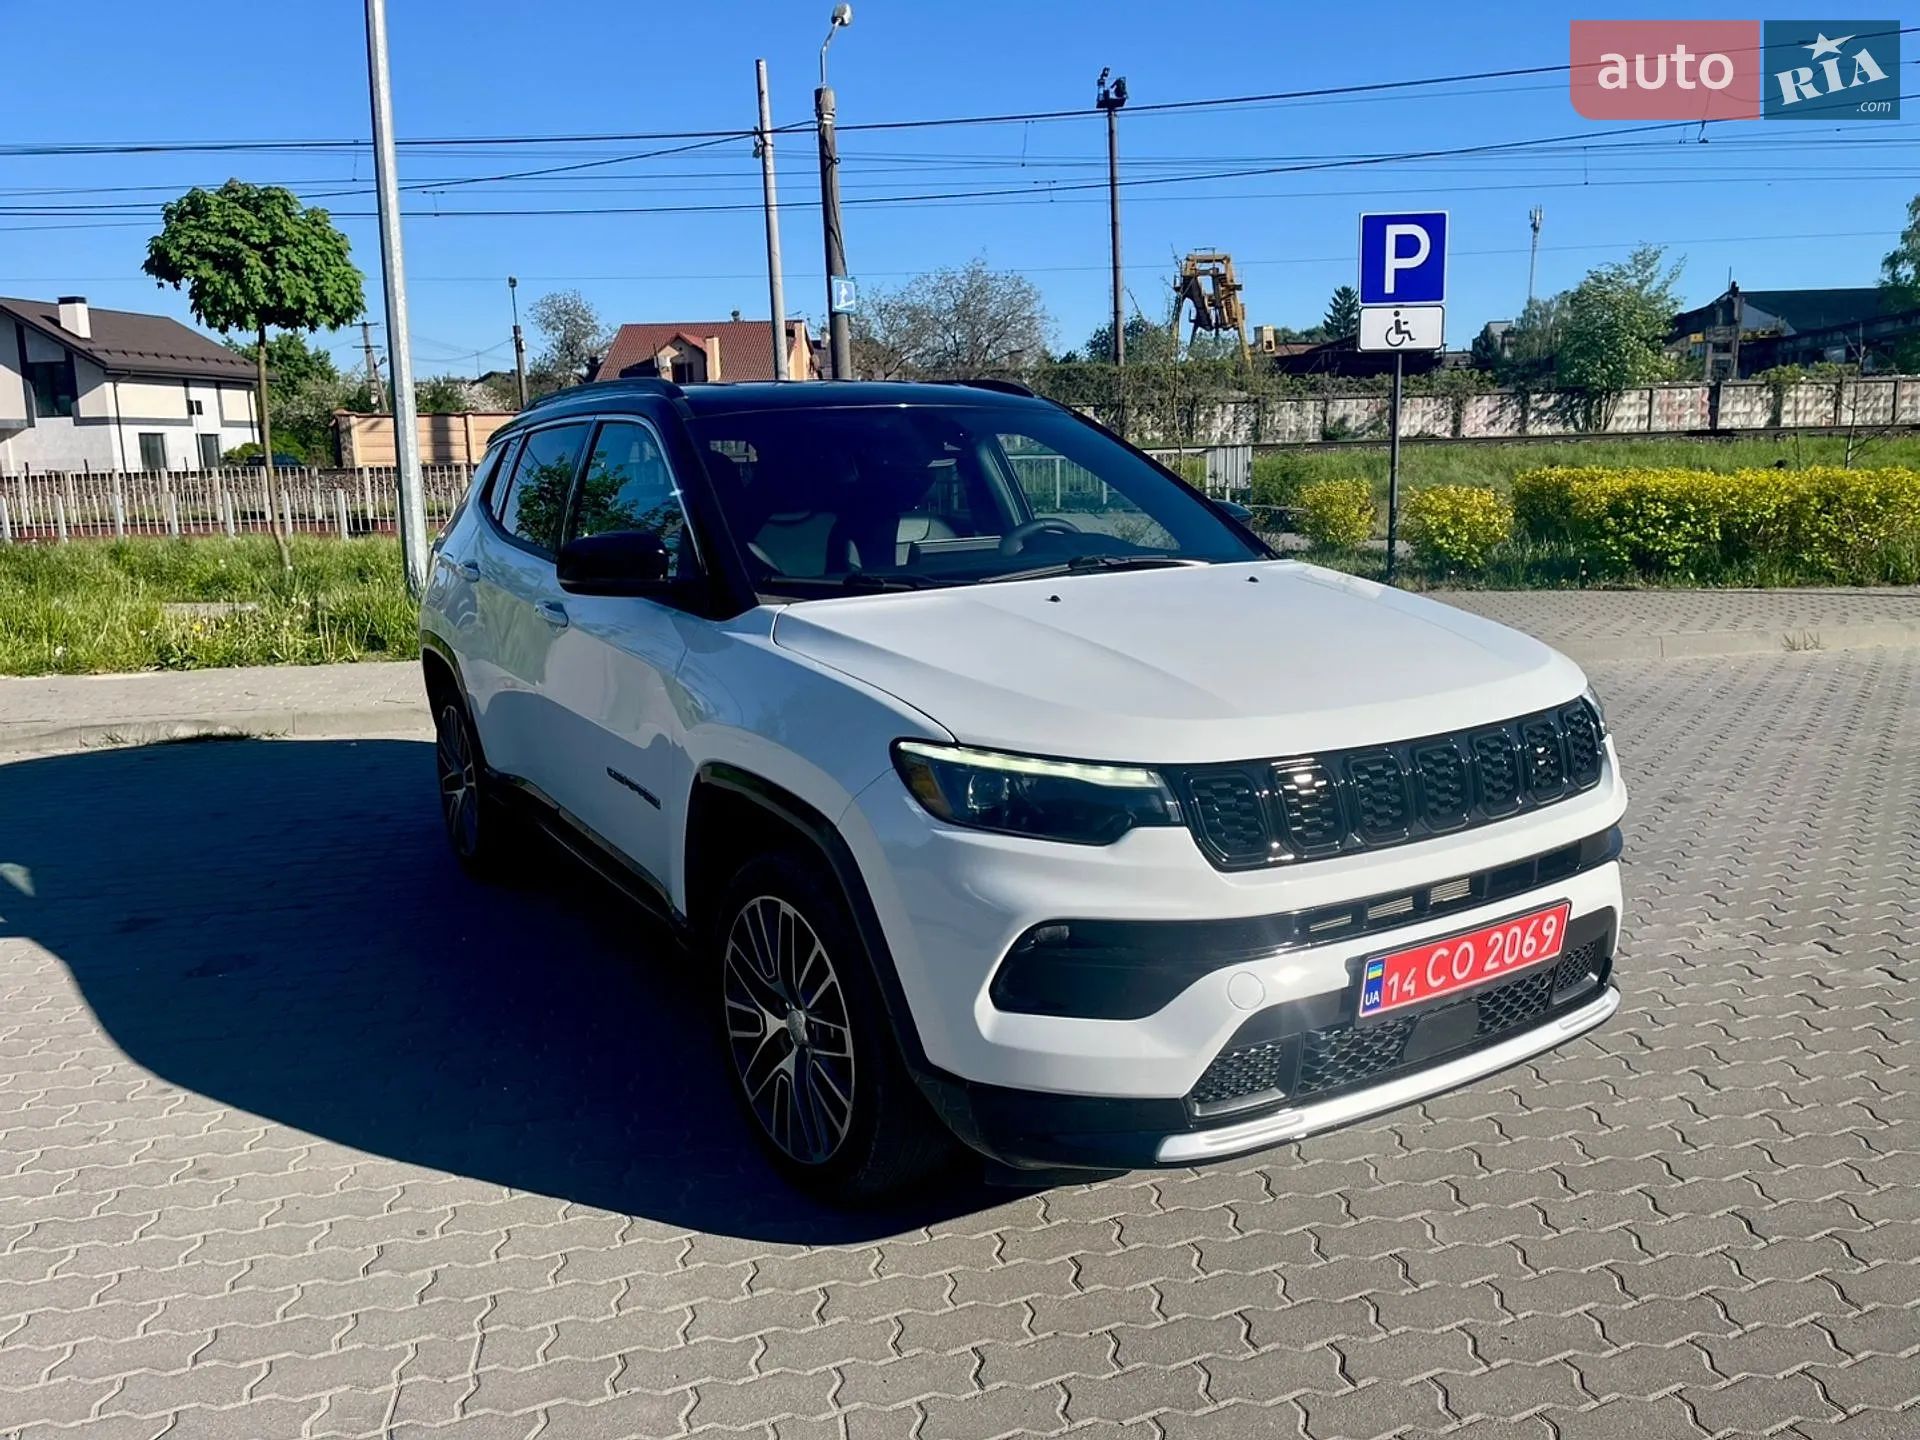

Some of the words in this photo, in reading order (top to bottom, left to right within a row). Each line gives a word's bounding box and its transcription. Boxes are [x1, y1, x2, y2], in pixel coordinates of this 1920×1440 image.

[1384, 224, 1431, 294] P
[1387, 967, 1417, 1001] 14
[1426, 941, 1475, 988] CO
[1484, 914, 1558, 972] 2069
[1365, 991, 1380, 1007] UA
